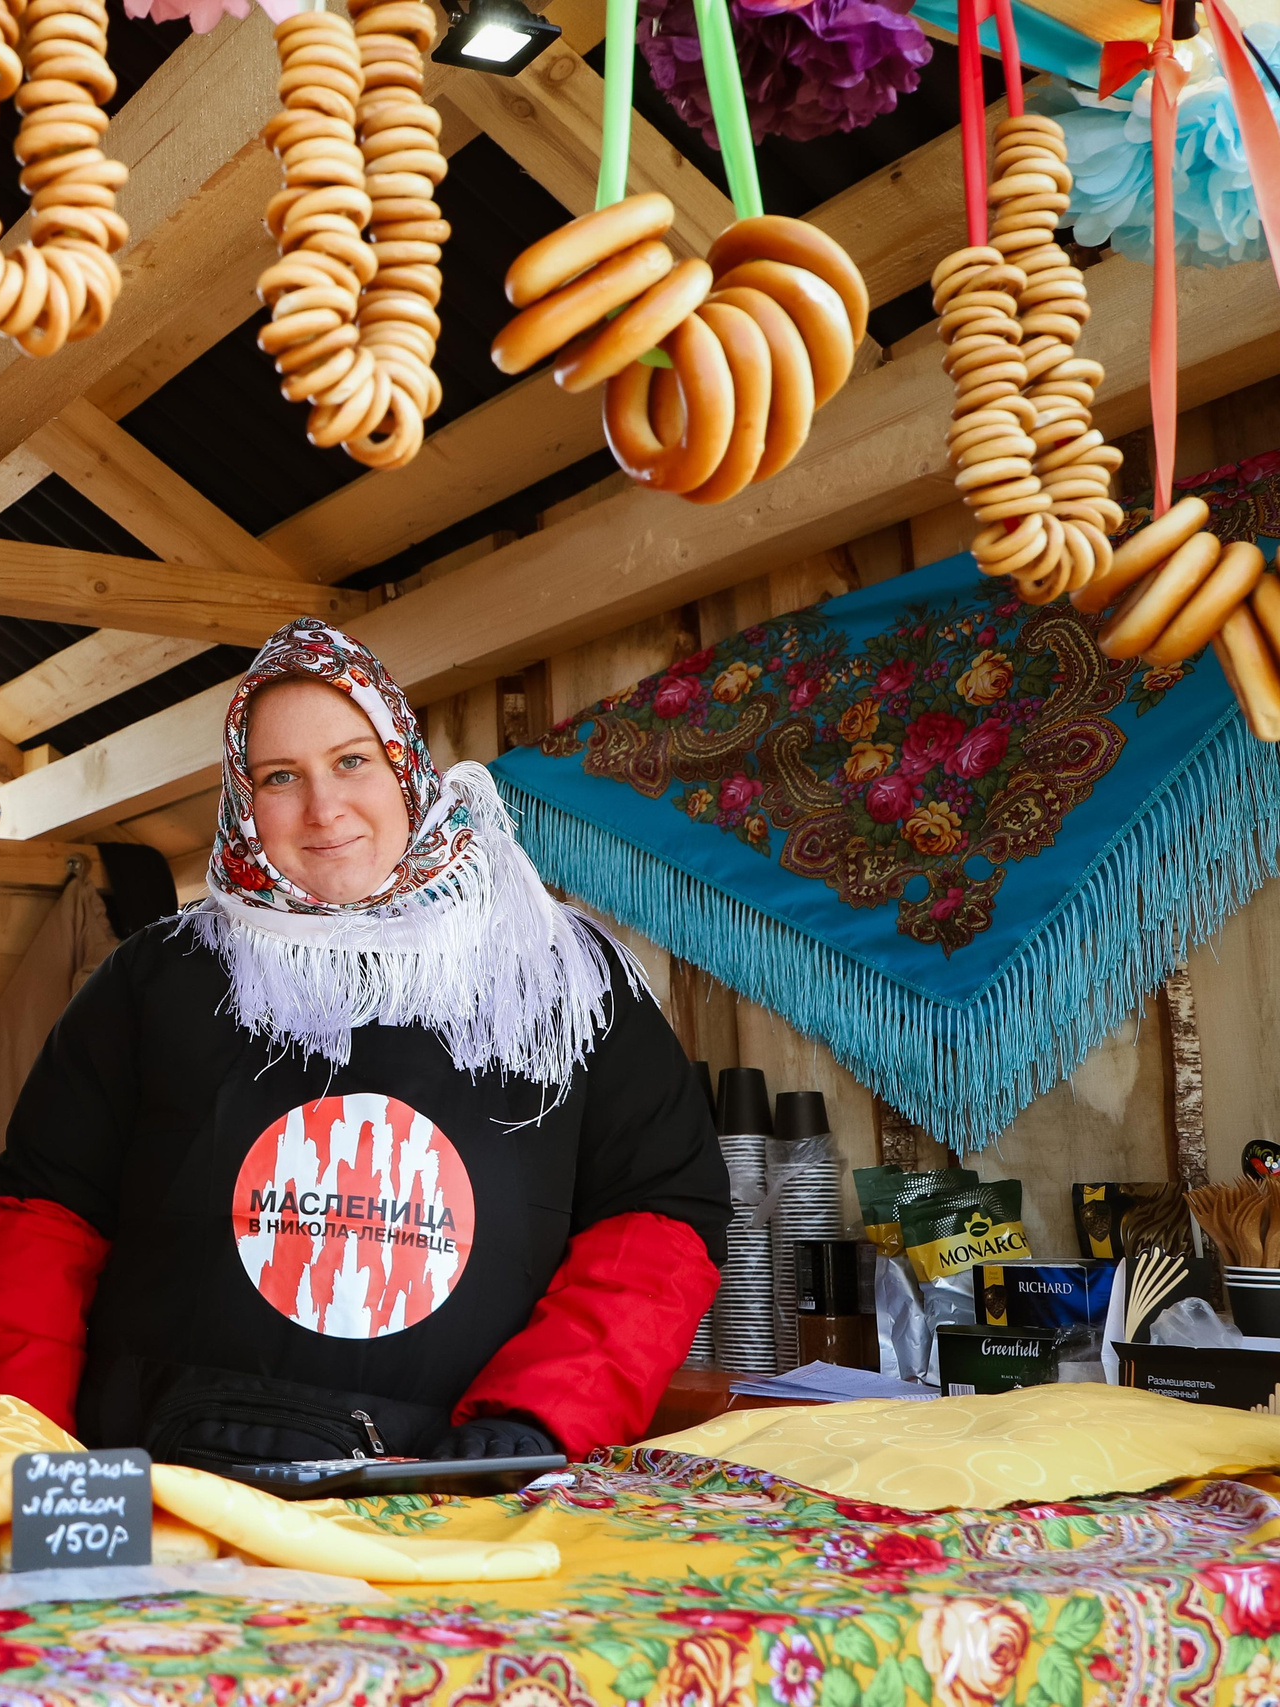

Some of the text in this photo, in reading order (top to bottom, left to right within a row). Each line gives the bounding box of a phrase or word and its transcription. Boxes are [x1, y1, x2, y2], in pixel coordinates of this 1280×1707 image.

[249, 1189, 456, 1233] МАСЛЕНИЦА
[249, 1218, 456, 1254] В НИКОЛА-ЛЕНИВЦЕ
[938, 1231, 1028, 1269] MONARCH
[1018, 1281, 1073, 1295] RICHARD
[981, 1338, 1040, 1357] Greenfield
[1147, 1375, 1216, 1390] Размешиватель
[26, 1453, 145, 1483] Пирожок
